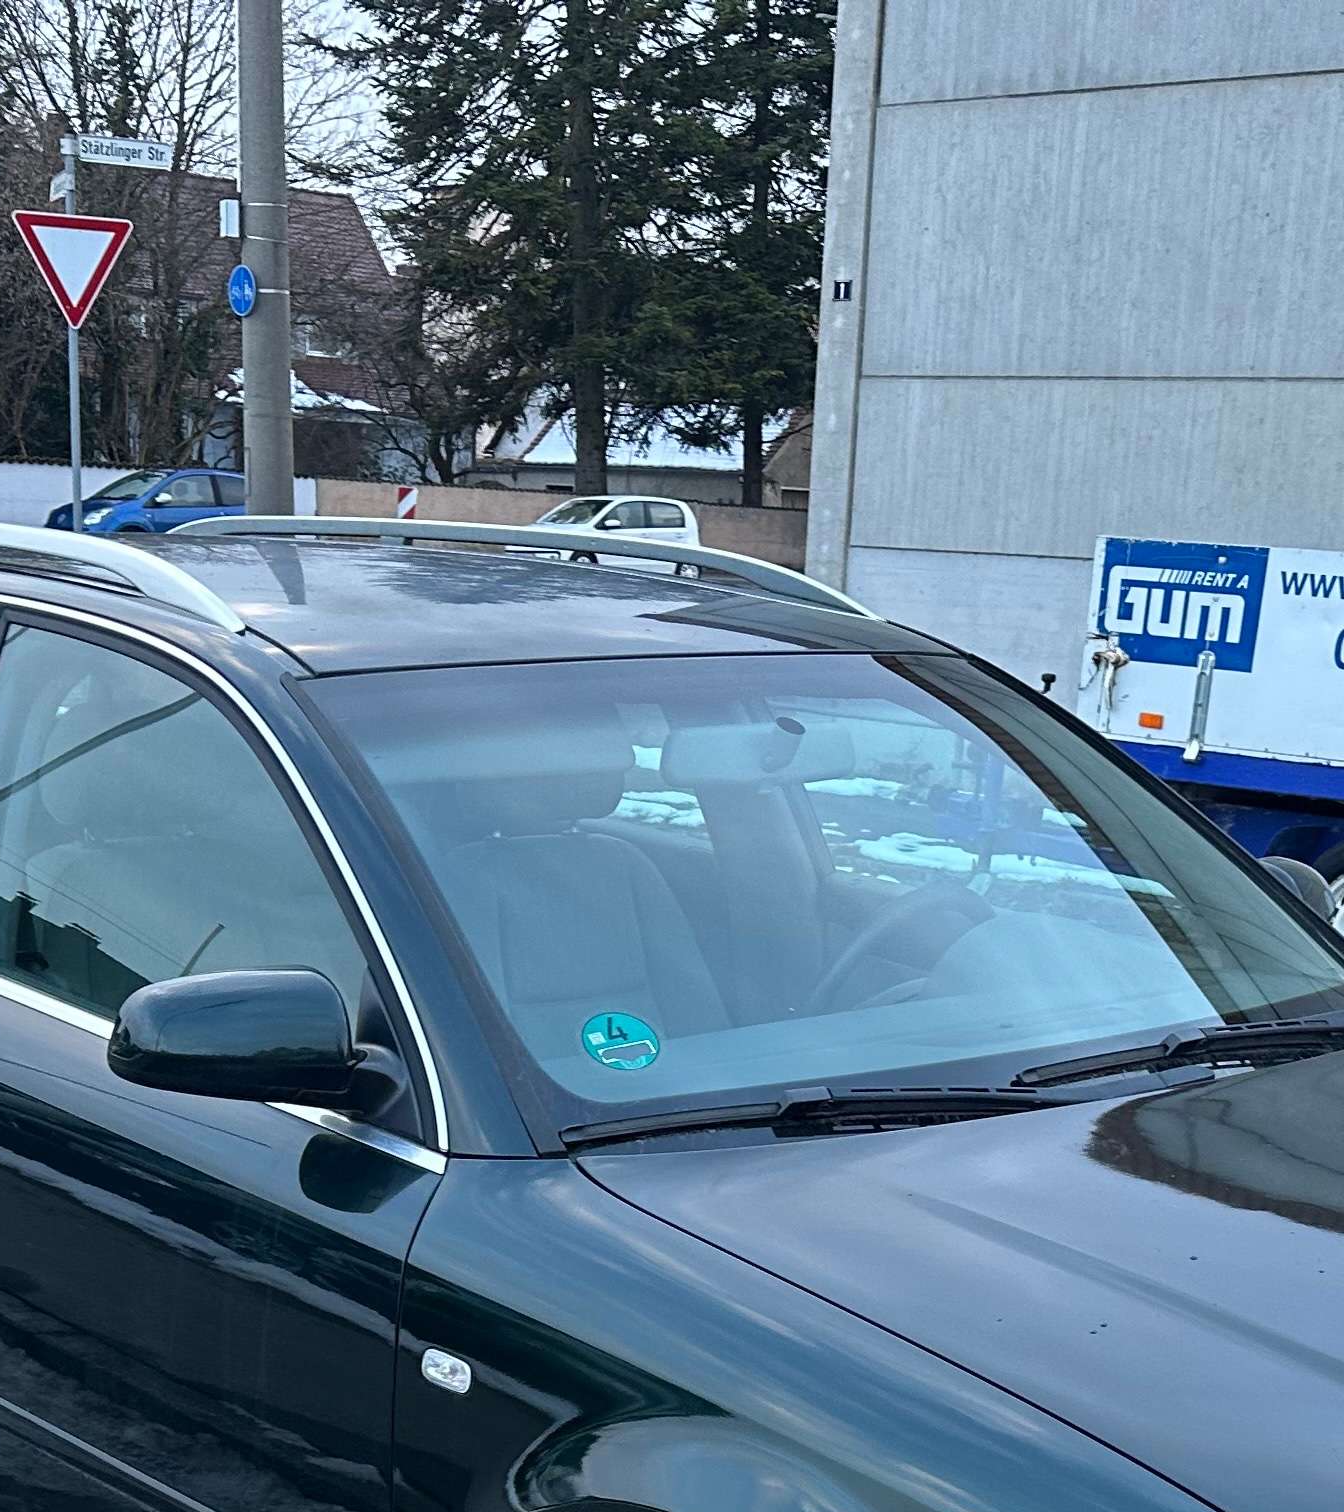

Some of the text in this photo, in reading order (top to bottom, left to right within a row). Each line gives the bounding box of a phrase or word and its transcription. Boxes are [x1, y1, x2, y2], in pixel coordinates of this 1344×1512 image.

[81, 139, 167, 161] Stätzlinger Str.
[1192, 570, 1249, 589] RENT A
[607, 1016, 628, 1041] 4
